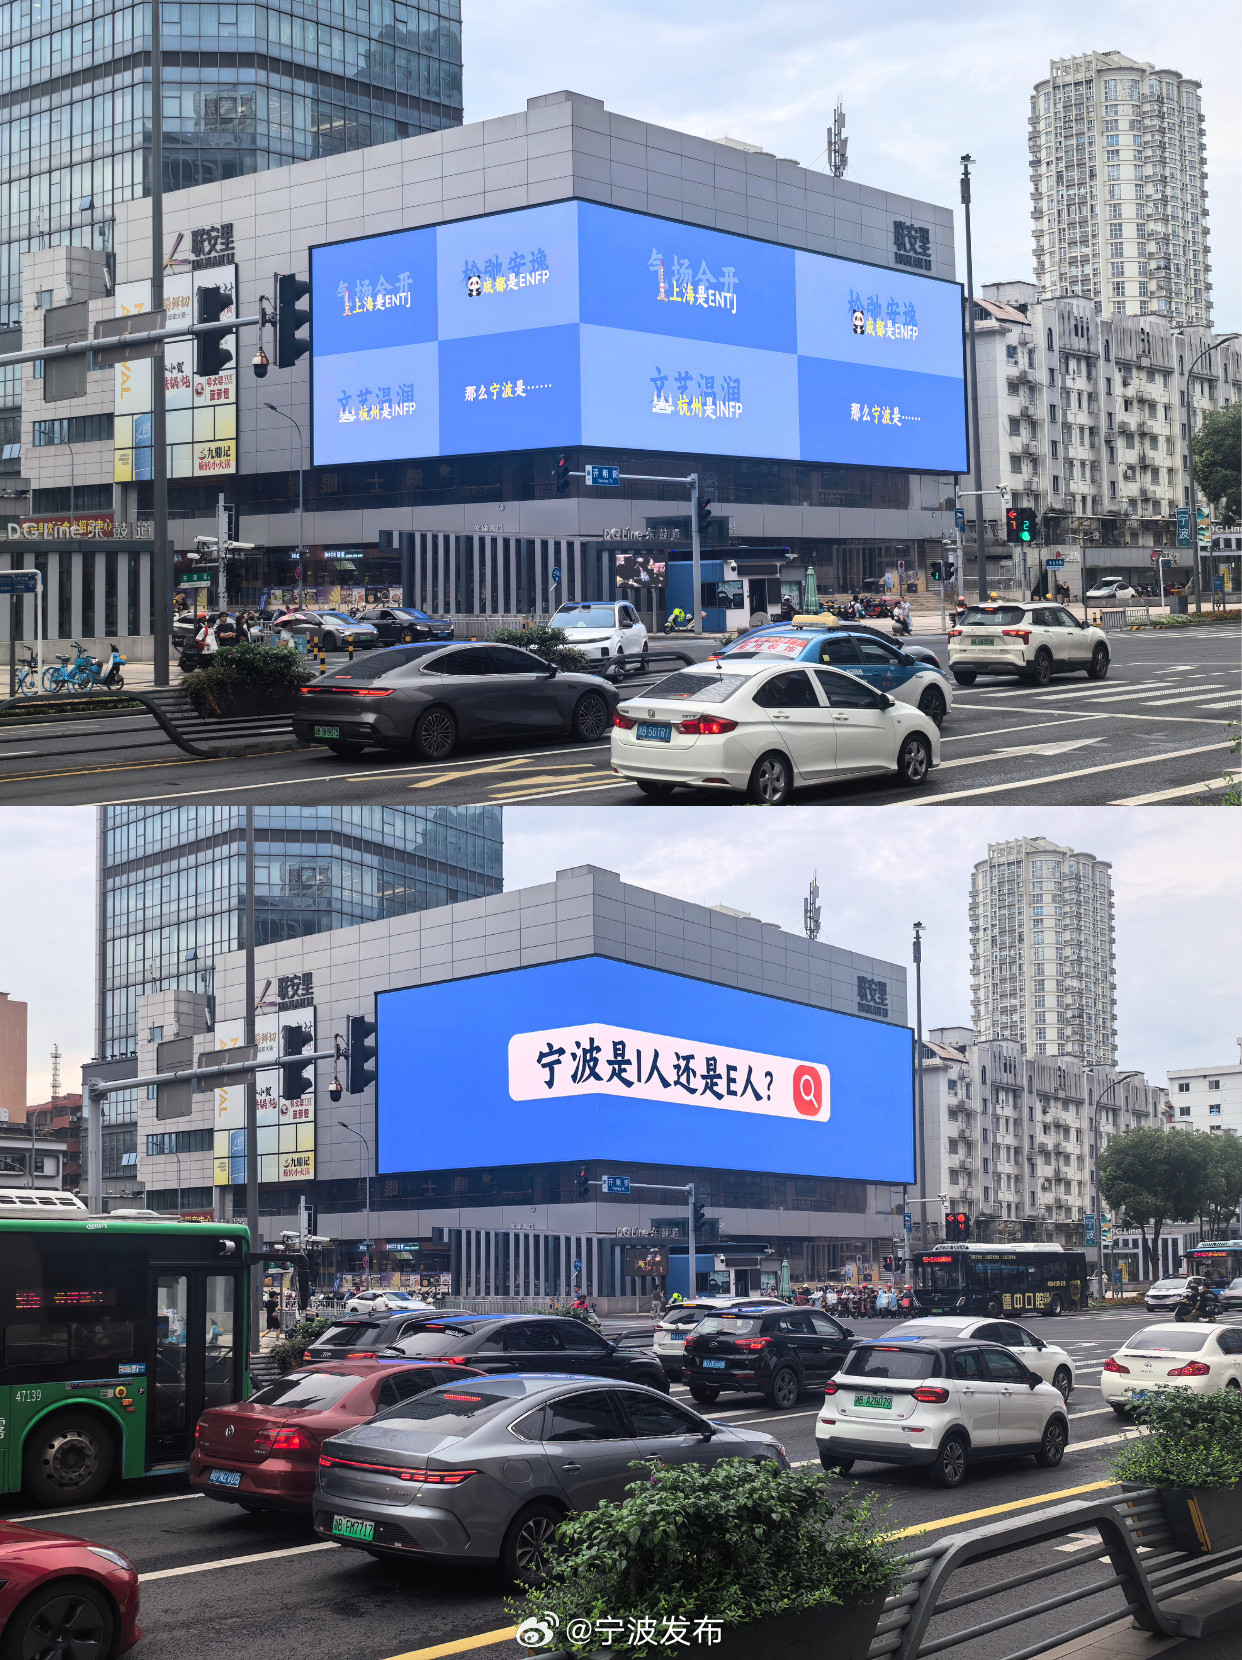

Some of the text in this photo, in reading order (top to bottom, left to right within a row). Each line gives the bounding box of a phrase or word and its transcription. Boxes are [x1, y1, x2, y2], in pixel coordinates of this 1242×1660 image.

[191, 222, 235, 258] 联安里
[893, 220, 932, 258] 联安里
[482, 270, 550, 295] 成都是ENFP
[352, 291, 412, 315] 上海是ENTJ
[669, 281, 737, 315] 上海是ENTJ
[865, 316, 919, 341] 成都是ENFP
[337, 383, 415, 414] 文艺温润
[650, 366, 741, 407] 文艺温润
[358, 401, 416, 421] 杭州是INFP
[676, 394, 743, 420] 杭州是INFP
[1023, 520, 1030, 530] 2
[1178, 513, 1189, 539] 宁波
[277, 971, 313, 1000] 联安里
[857, 975, 888, 1007] 联安里
[1086, 1219, 1095, 1240] 宁波
[15, 1389, 42, 1402] 47139
